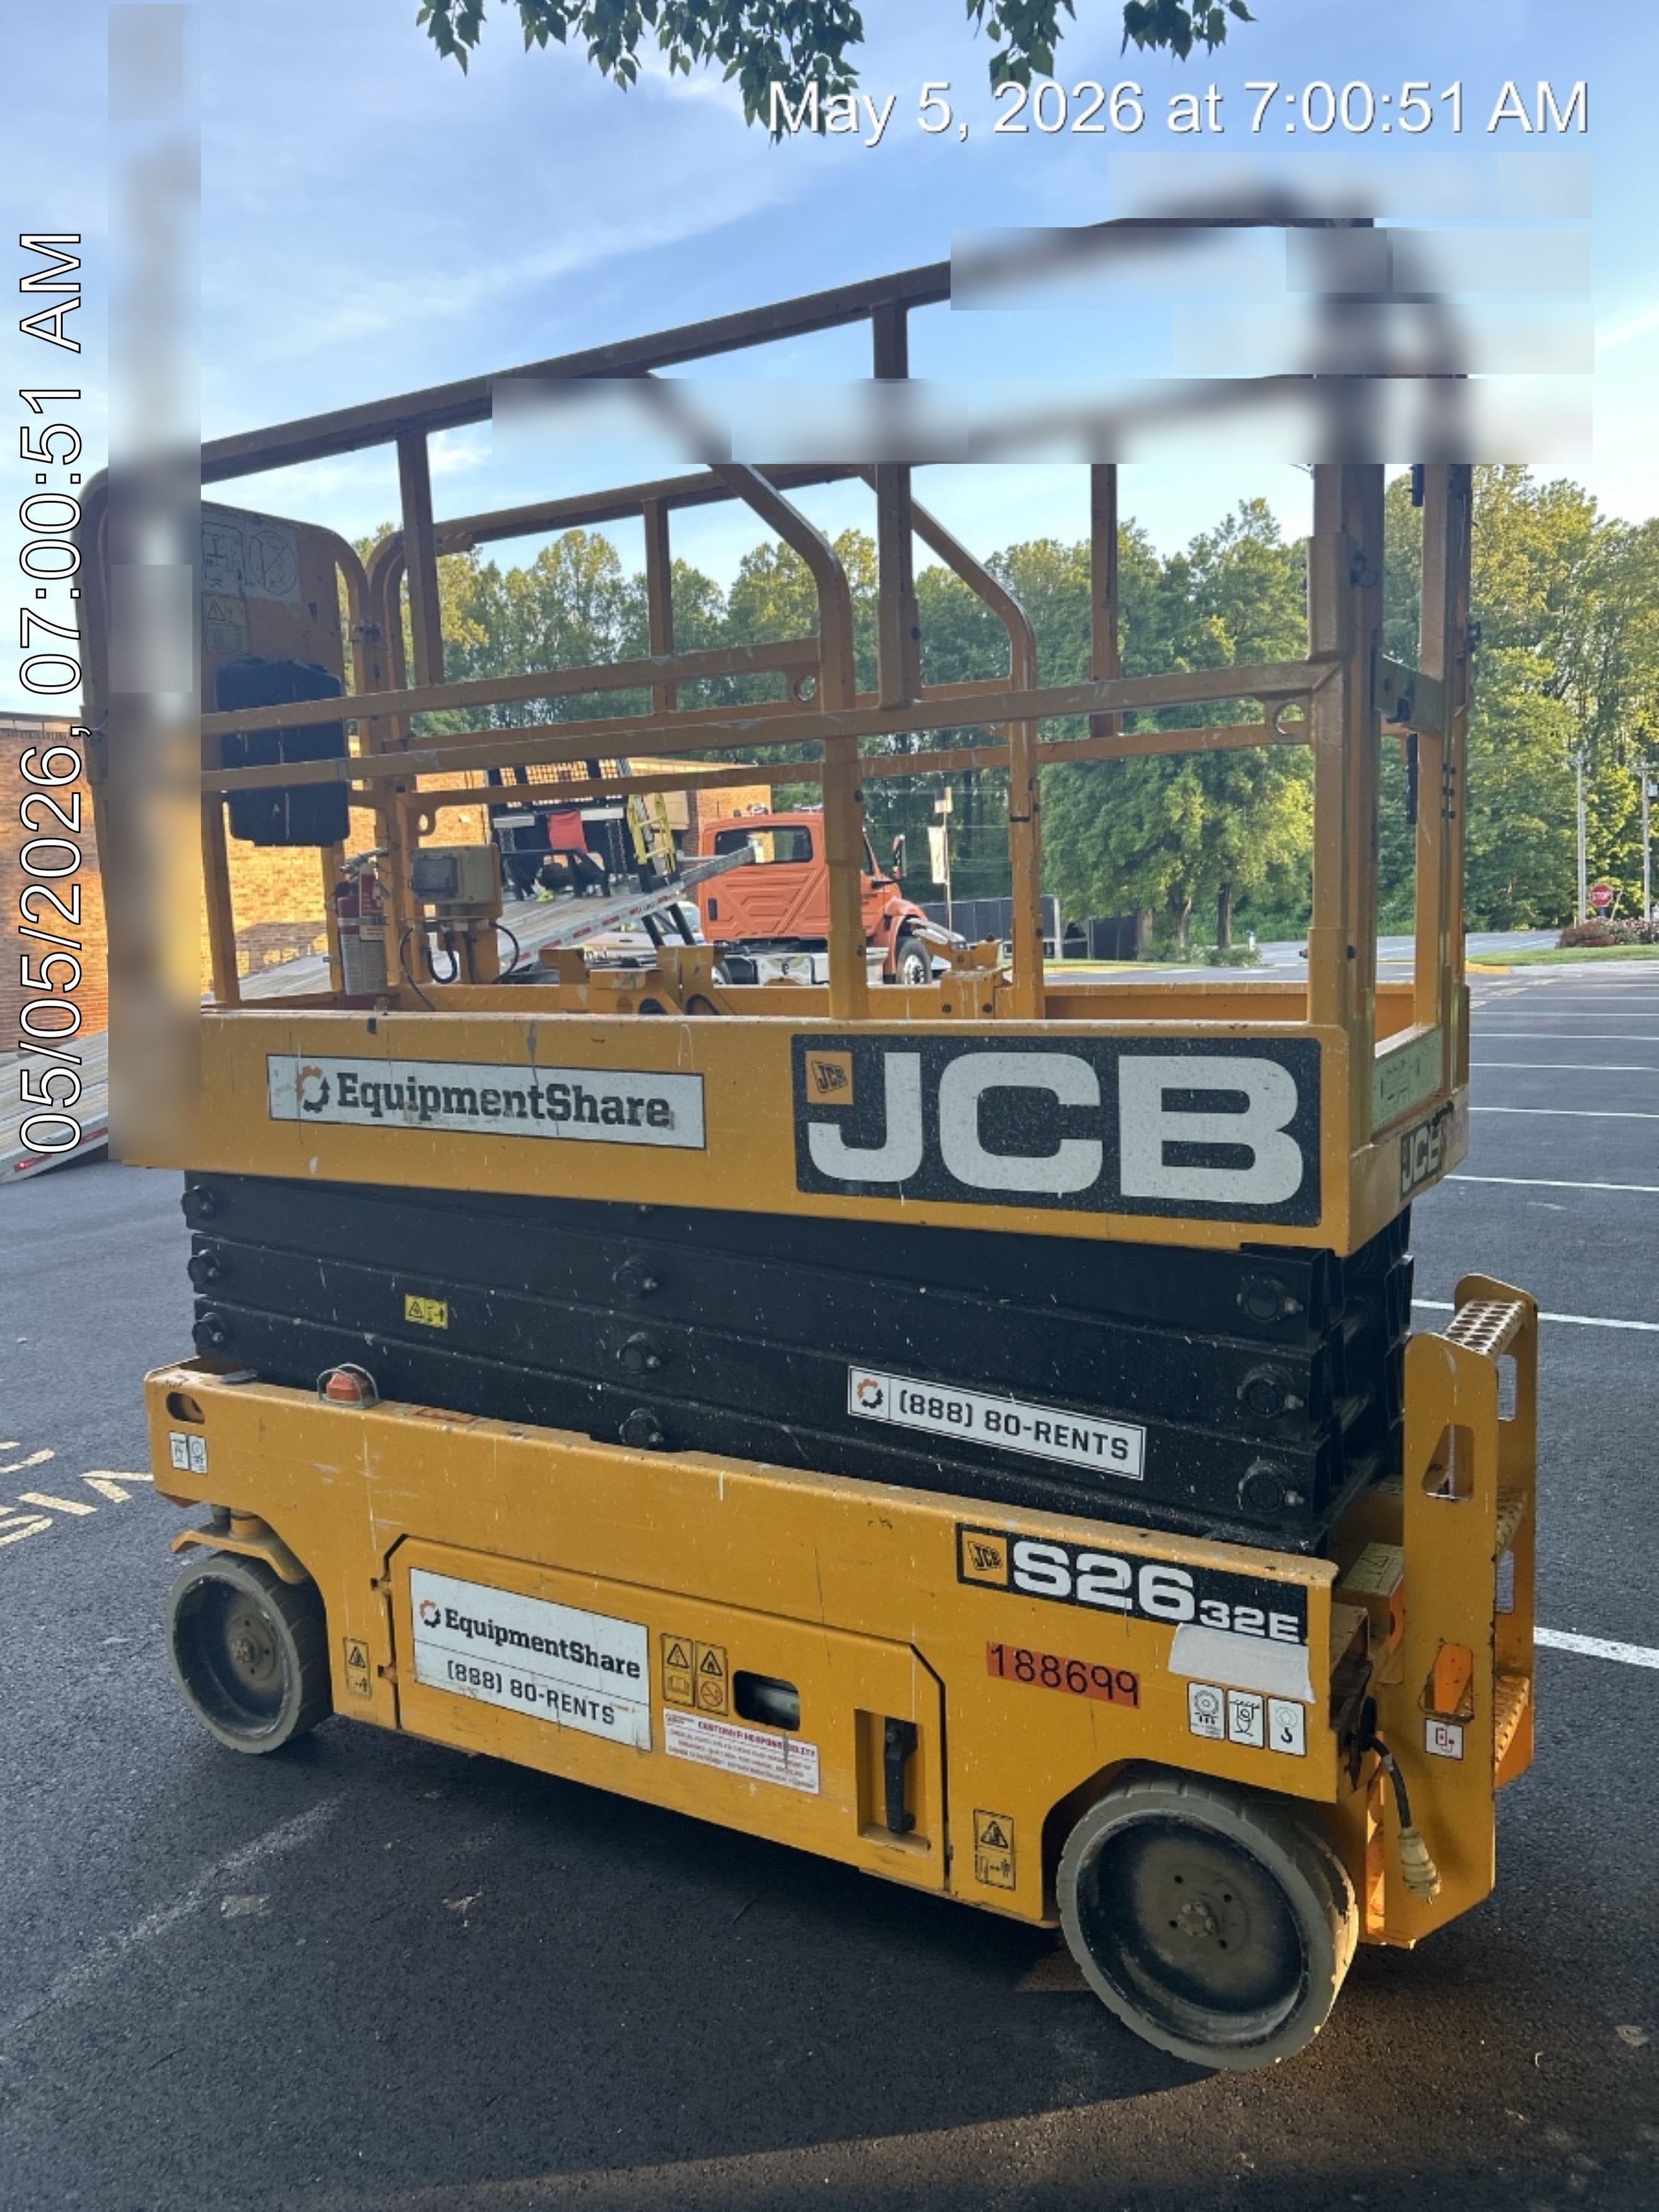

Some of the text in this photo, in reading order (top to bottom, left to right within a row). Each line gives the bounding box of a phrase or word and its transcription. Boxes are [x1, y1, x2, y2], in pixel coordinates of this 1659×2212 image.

[336, 1072, 670, 1127] EquipmentShare
[811, 1061, 847, 1092] JCB
[807, 1051, 1304, 1205] JCB
[900, 1389, 1129, 1461] (888) 80-RENTS
[444, 1607, 640, 1679] EquipmentShare
[990, 1643, 1139, 1706] 188699
[447, 1660, 615, 1725] (888) 80-RENTS
